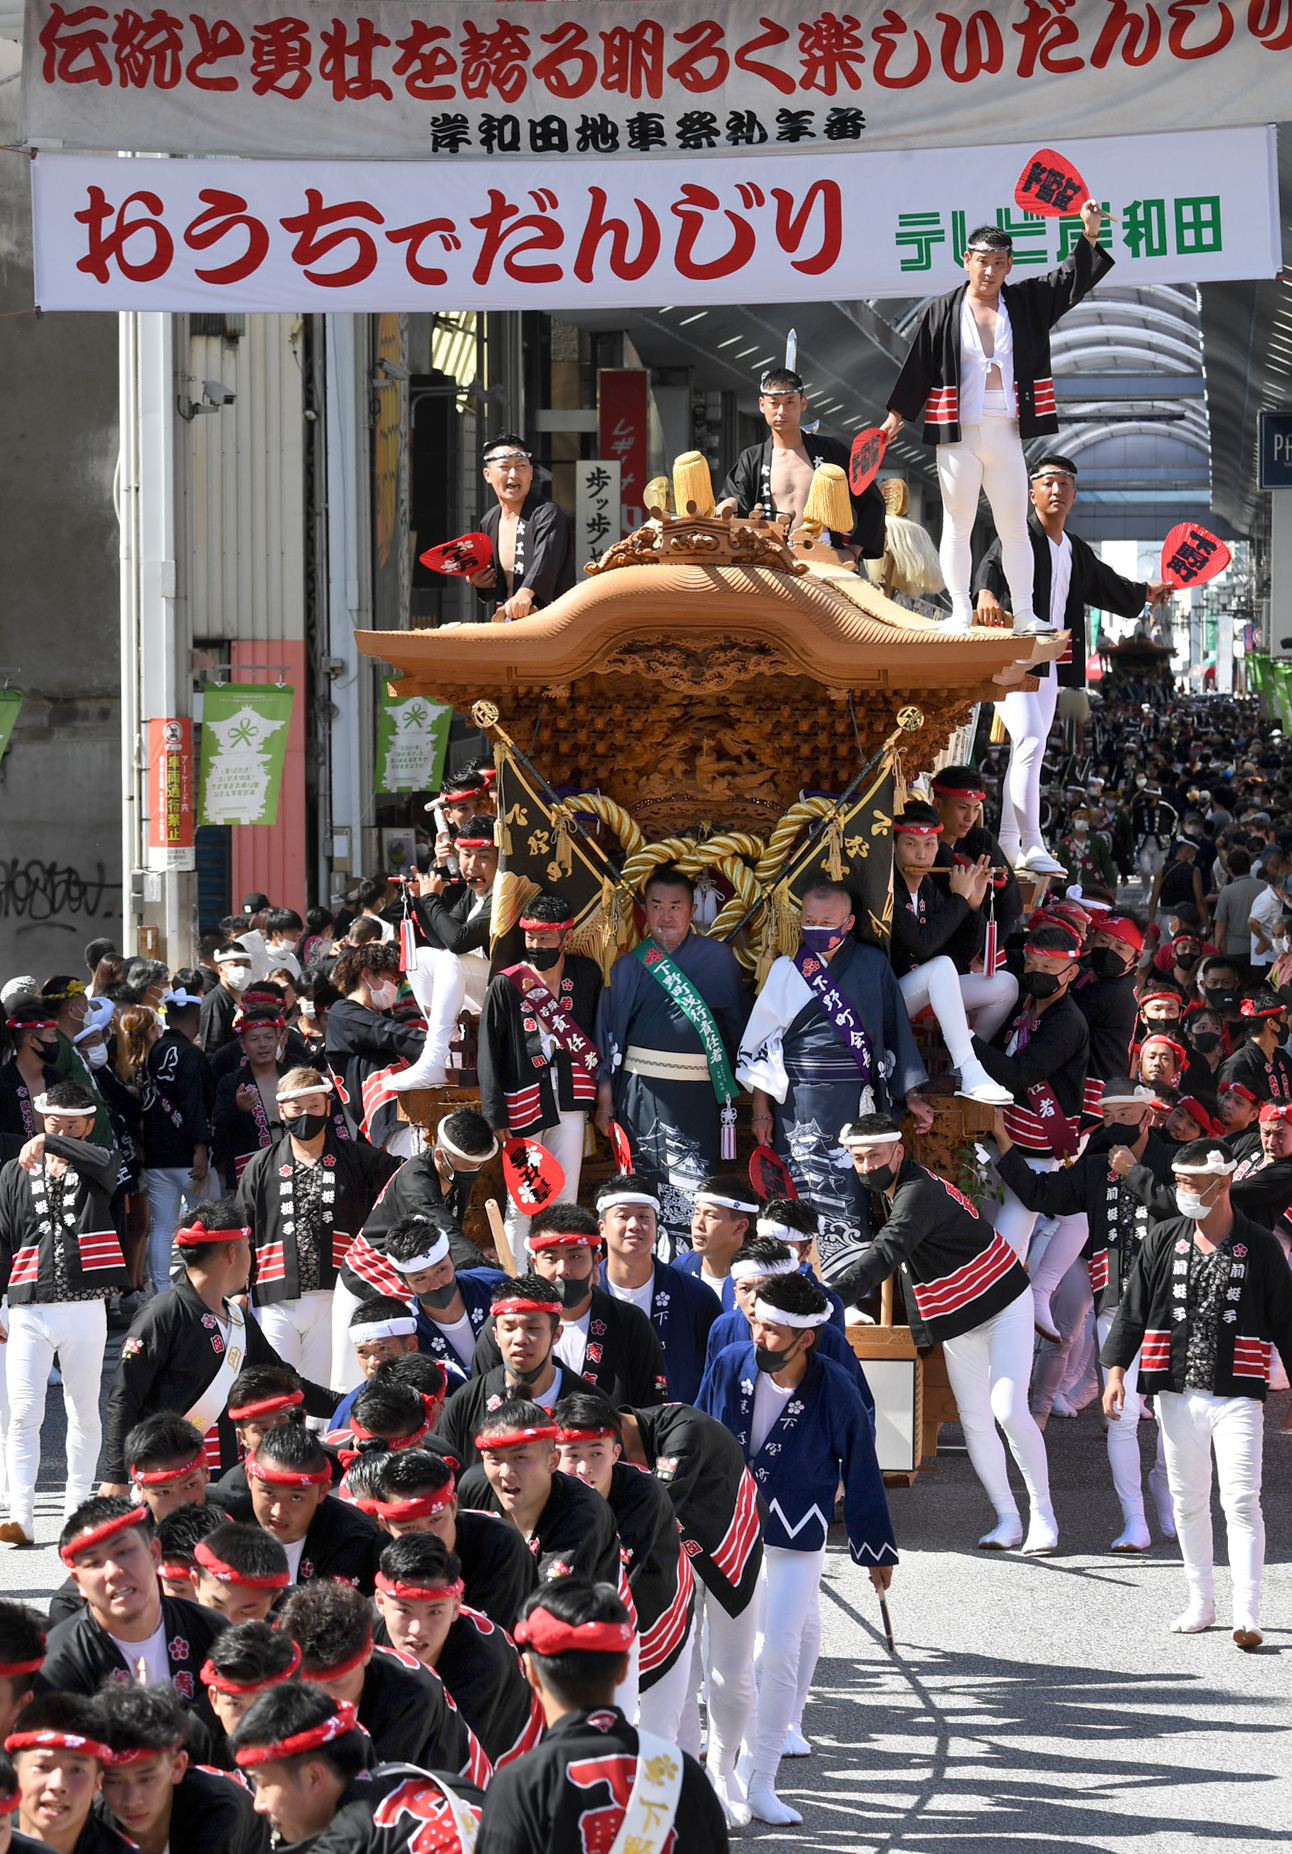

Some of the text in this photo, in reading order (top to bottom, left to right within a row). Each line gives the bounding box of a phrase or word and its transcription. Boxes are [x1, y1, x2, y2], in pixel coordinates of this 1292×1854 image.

[430, 106, 867, 154] 岸和田地車祭礼年番
[74, 179, 843, 288] おうちでだんじり
[513, 521, 526, 576] 大工方
[167, 755, 182, 842] 車両通行禁止
[181, 755, 189, 813] アーケード内
[551, 1014, 599, 1071] 責任者
[812, 975, 872, 1069] 下野町会長
